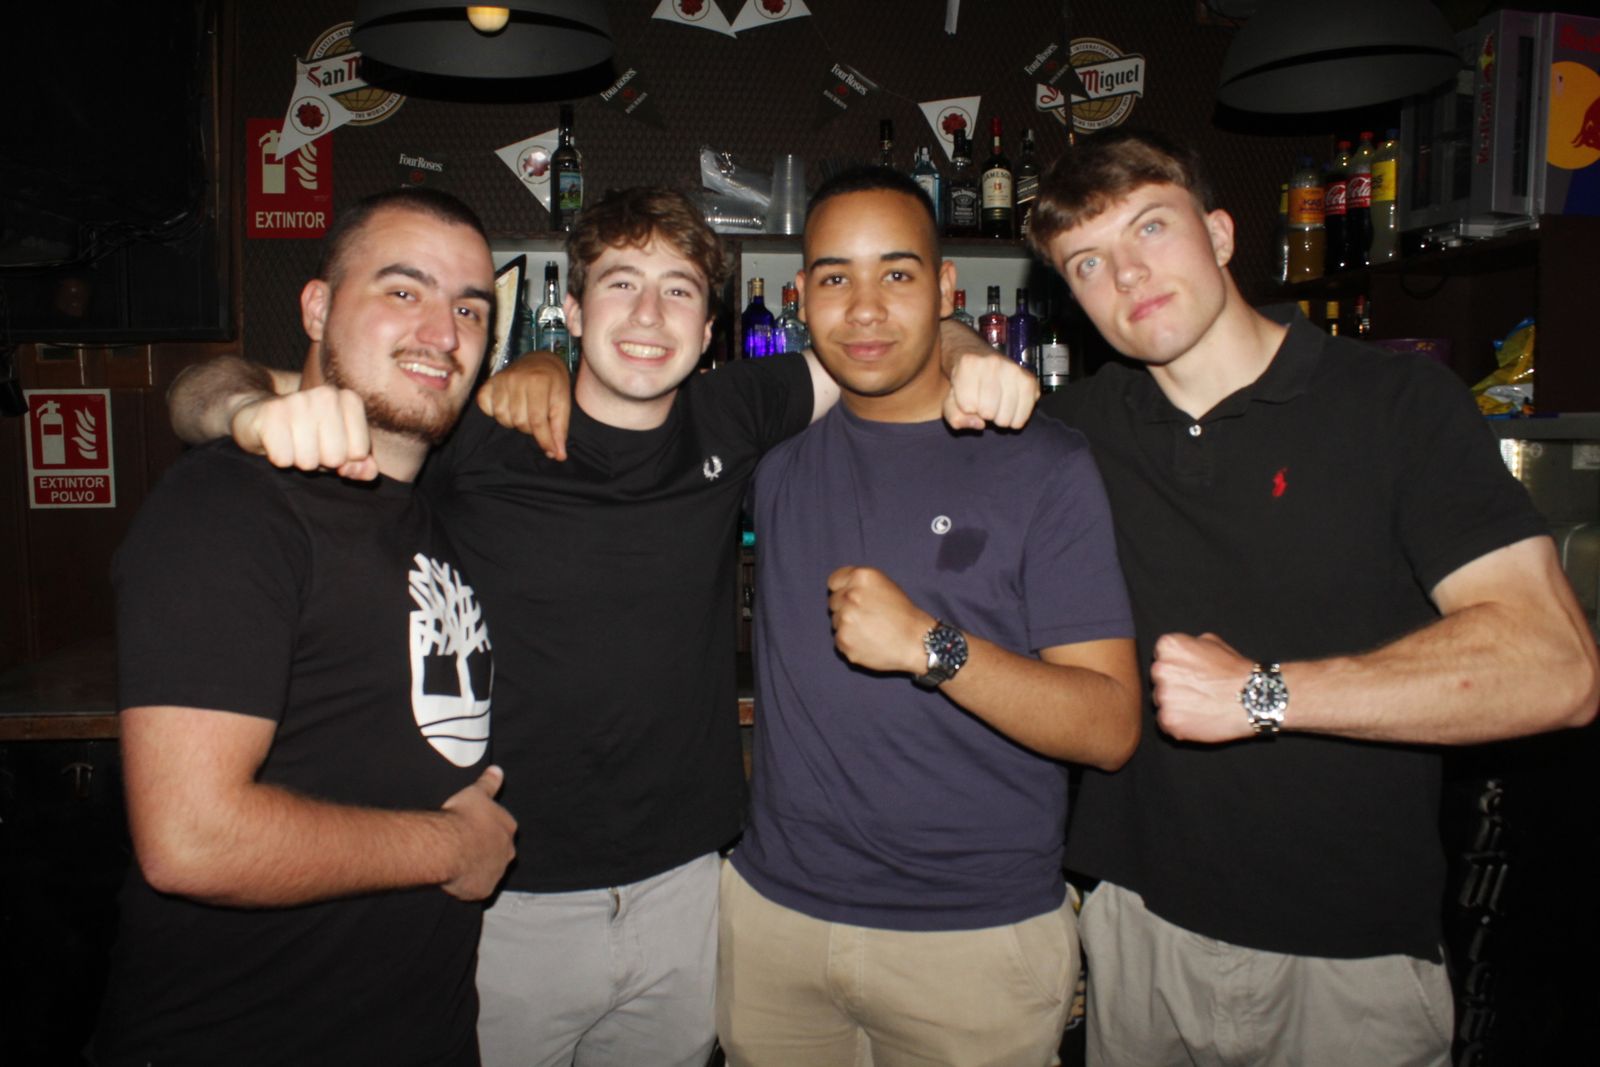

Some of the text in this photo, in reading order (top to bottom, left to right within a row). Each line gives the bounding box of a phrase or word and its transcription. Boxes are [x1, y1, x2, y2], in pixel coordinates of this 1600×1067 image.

[1079, 64, 1140, 94] Miguel
[255, 211, 326, 229] EXTINTOR
[39, 477, 105, 489] EXTINTOR
[50, 490, 95, 503] POLVO
